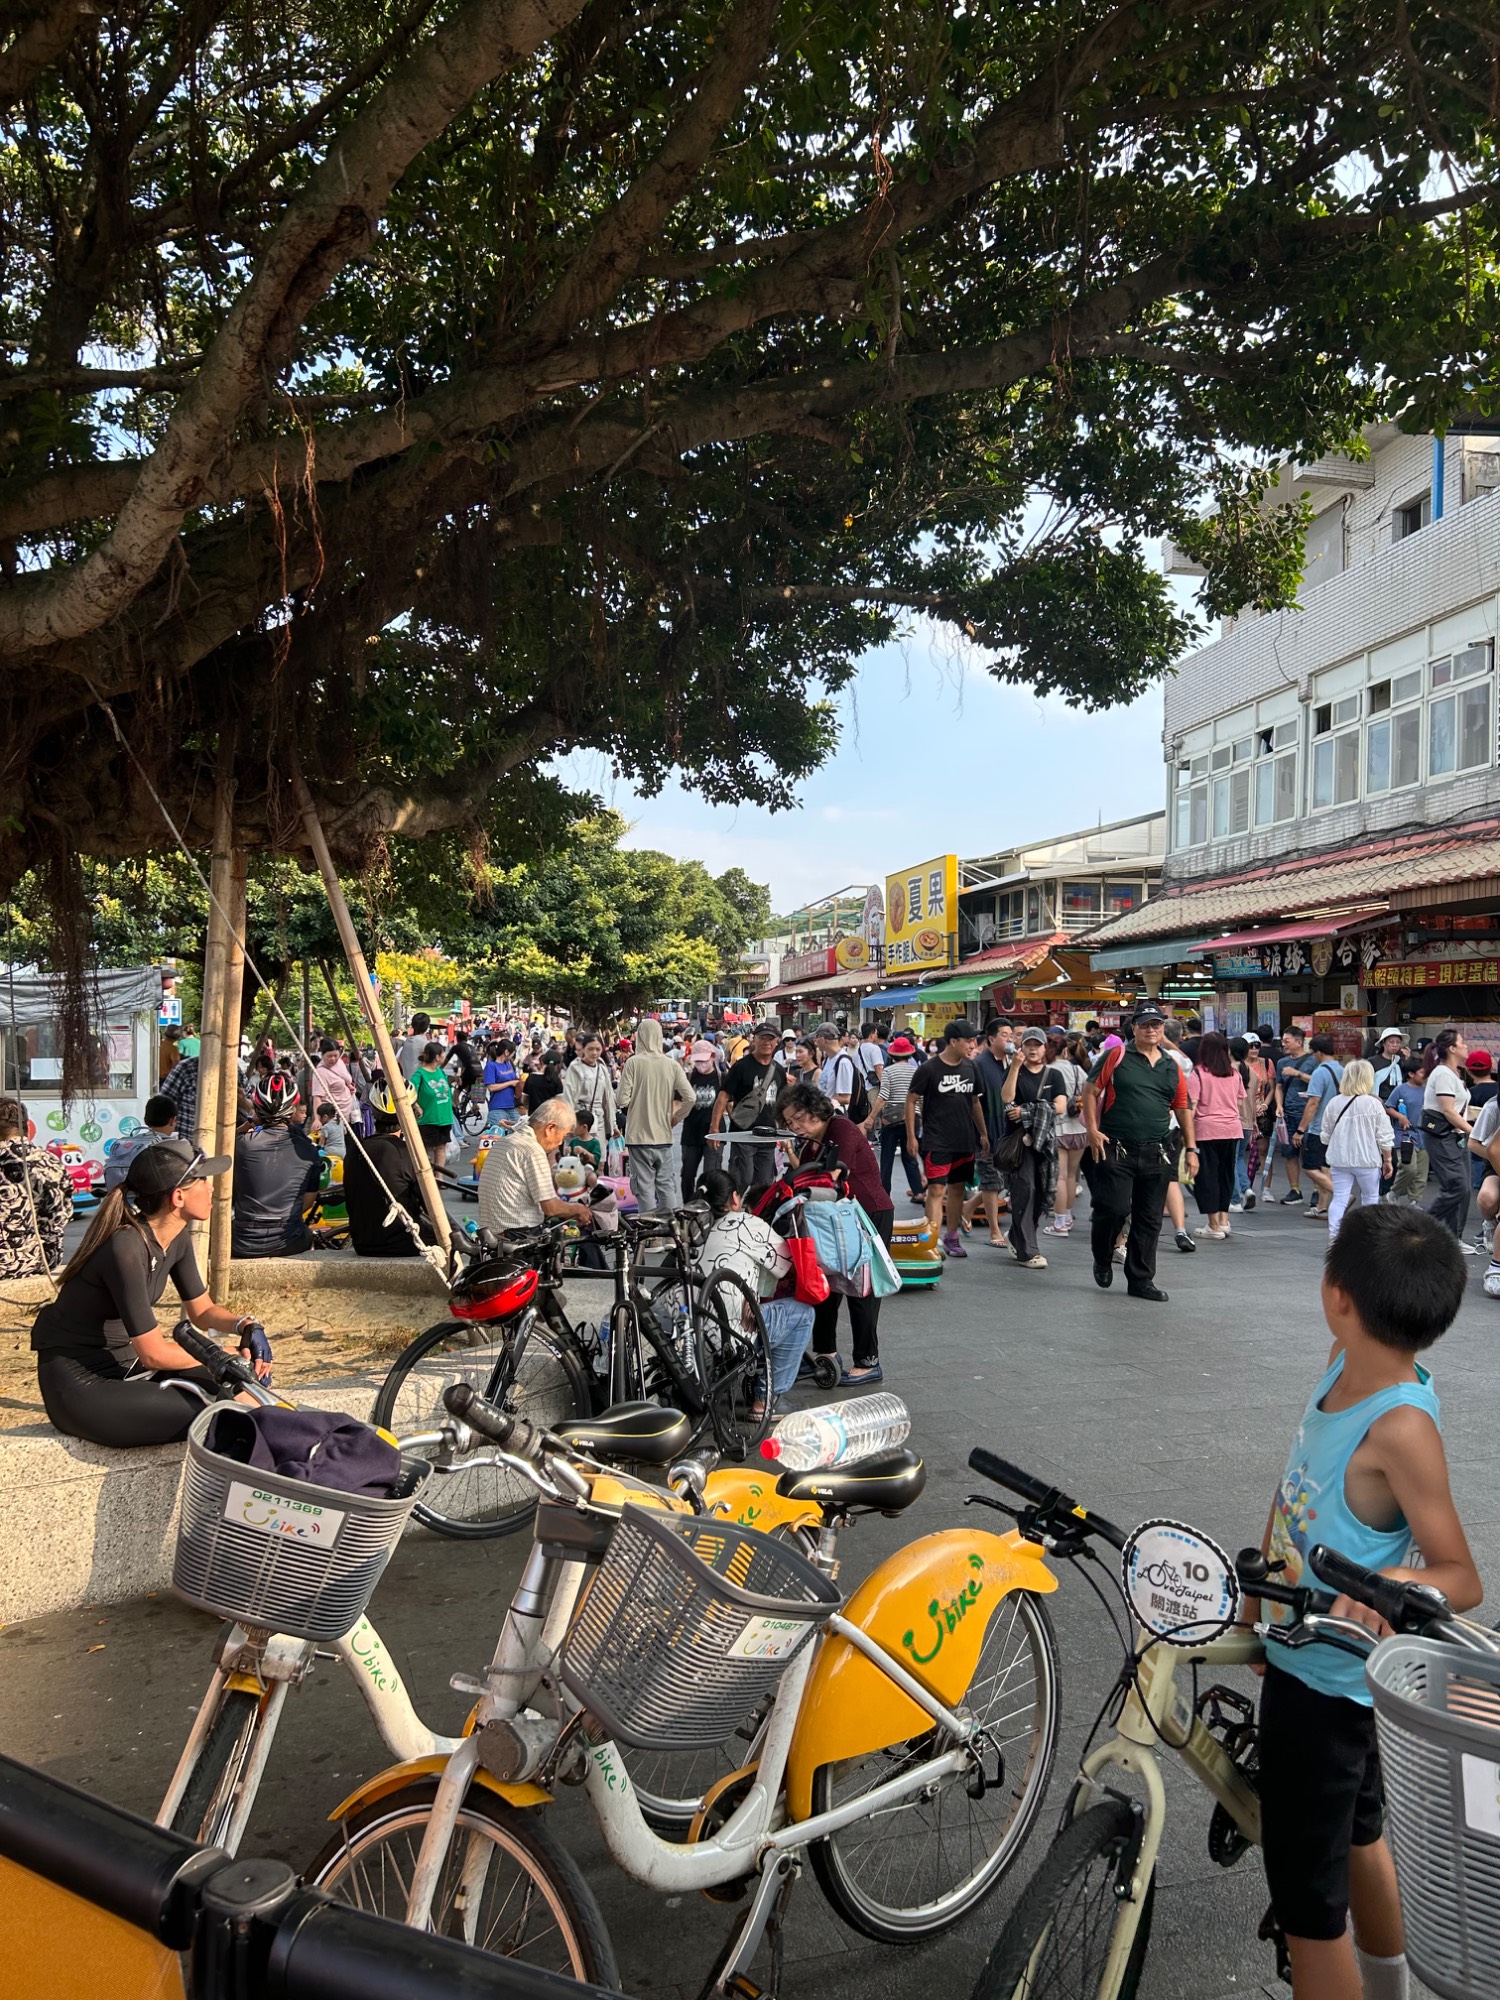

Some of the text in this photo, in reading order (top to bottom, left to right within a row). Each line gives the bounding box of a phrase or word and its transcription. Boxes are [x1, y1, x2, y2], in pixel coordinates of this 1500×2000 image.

[943, 1075, 961, 1085] JUST
[955, 1083, 974, 1093] DO IT
[251, 1489, 323, 1516] 0211369
[1182, 1561, 1210, 1583] 10
[1174, 1584, 1214, 1603] Taipei
[1150, 1592, 1199, 1621] 關渡站
[762, 1620, 803, 1631] 0104877
